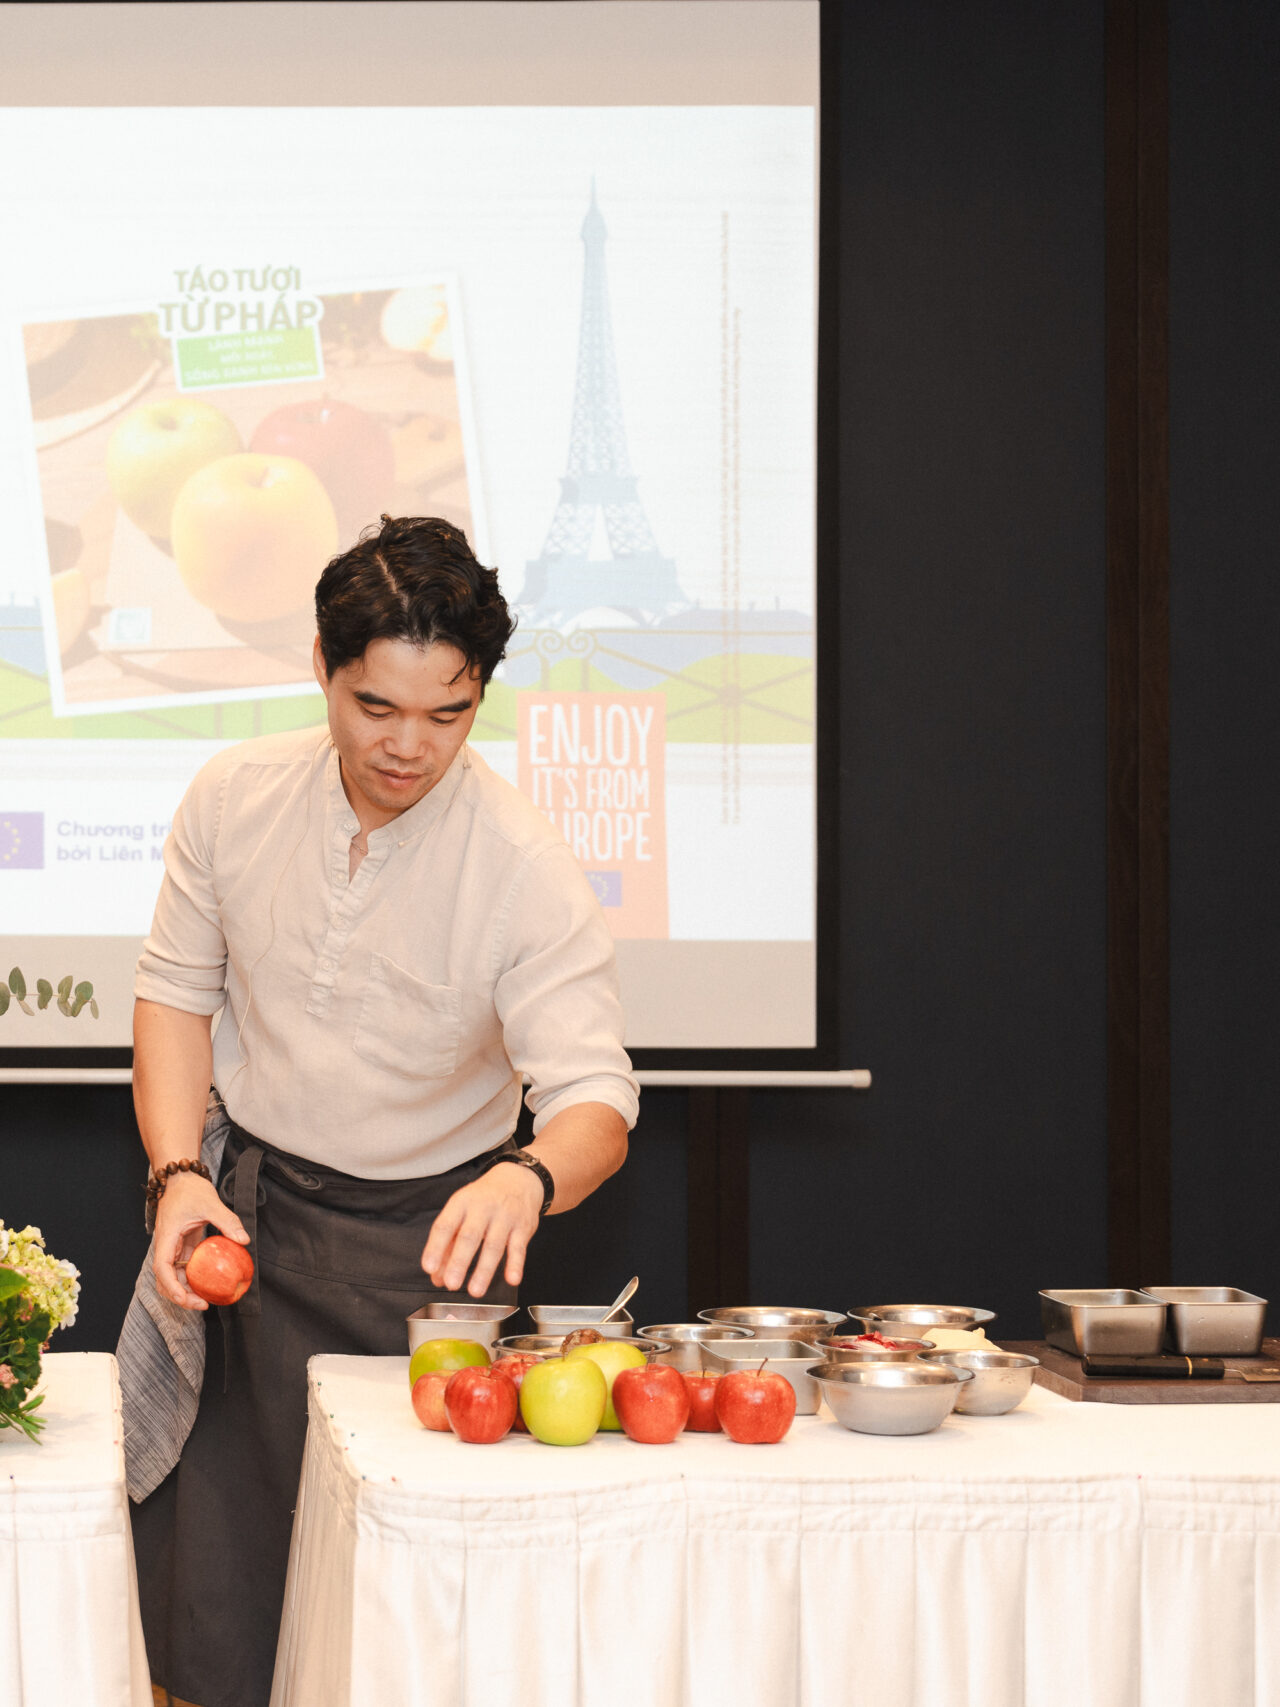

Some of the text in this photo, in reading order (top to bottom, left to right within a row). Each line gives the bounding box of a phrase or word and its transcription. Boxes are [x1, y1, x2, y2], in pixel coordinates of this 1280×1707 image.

[173, 264, 301, 292] TÁO TƯƠI
[158, 292, 318, 332] TỪ PHÁP
[529, 703, 655, 767] ENJOY
[532, 767, 650, 810] IT'S FROM
[56, 820, 145, 842] Chương
[542, 810, 653, 862] ROPE
[56, 844, 92, 862] bởi
[99, 844, 144, 862] Liên
